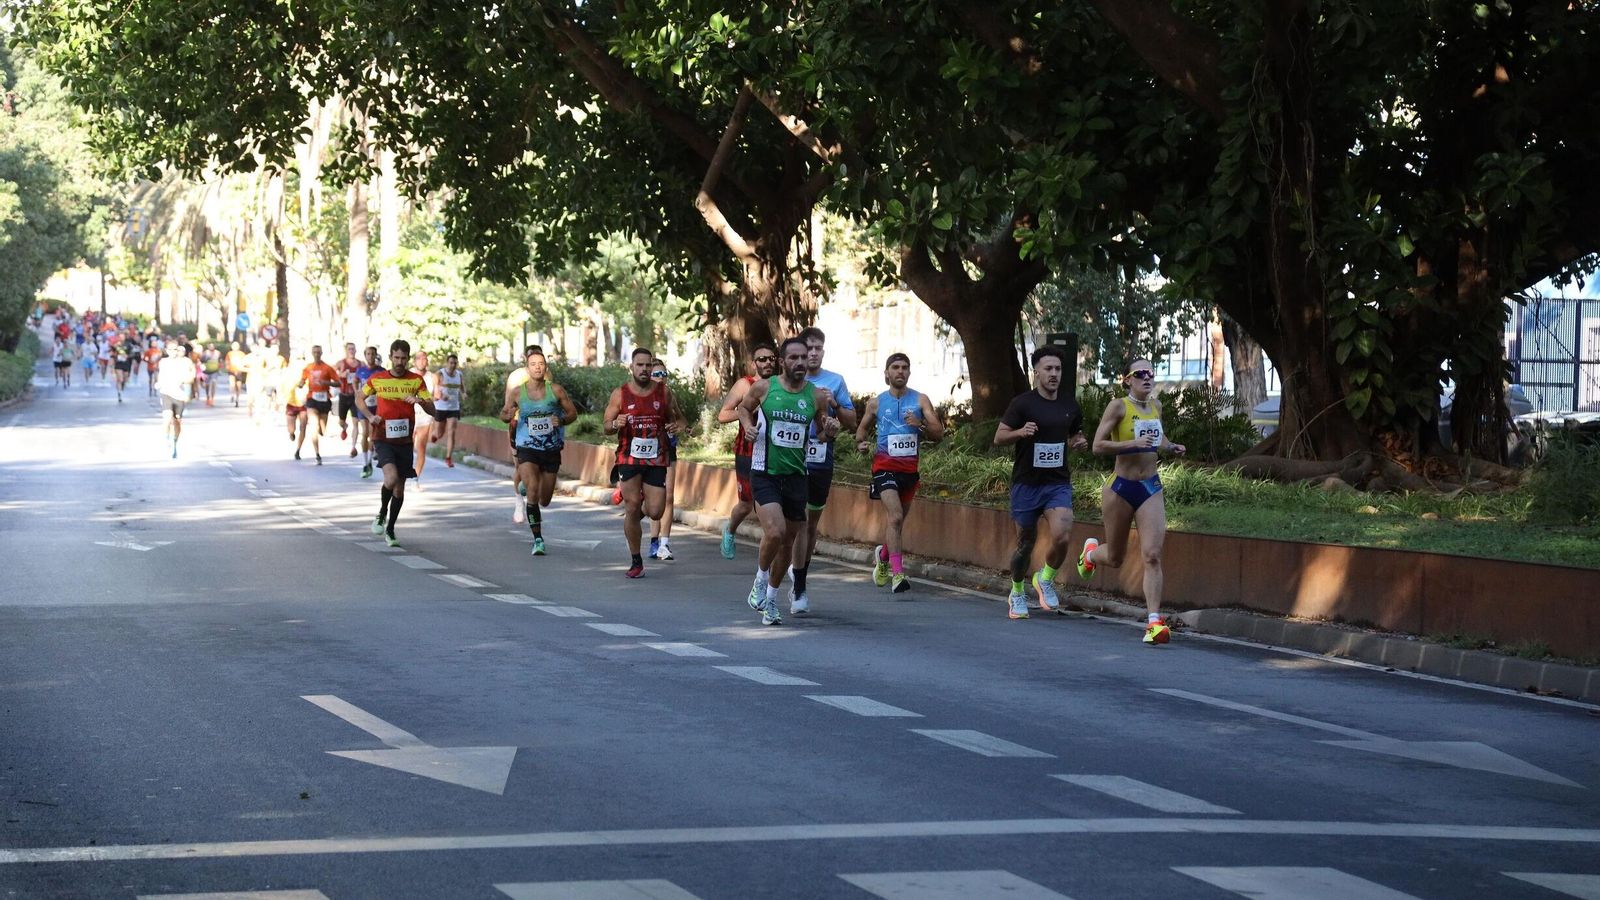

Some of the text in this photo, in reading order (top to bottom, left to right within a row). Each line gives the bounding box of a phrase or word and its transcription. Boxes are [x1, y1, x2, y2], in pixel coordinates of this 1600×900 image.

[772, 408, 807, 422] mijas
[776, 430, 800, 441] 410
[635, 444, 653, 453] 787
[892, 441, 916, 449] 1030
[1039, 451, 1060, 461] 226
